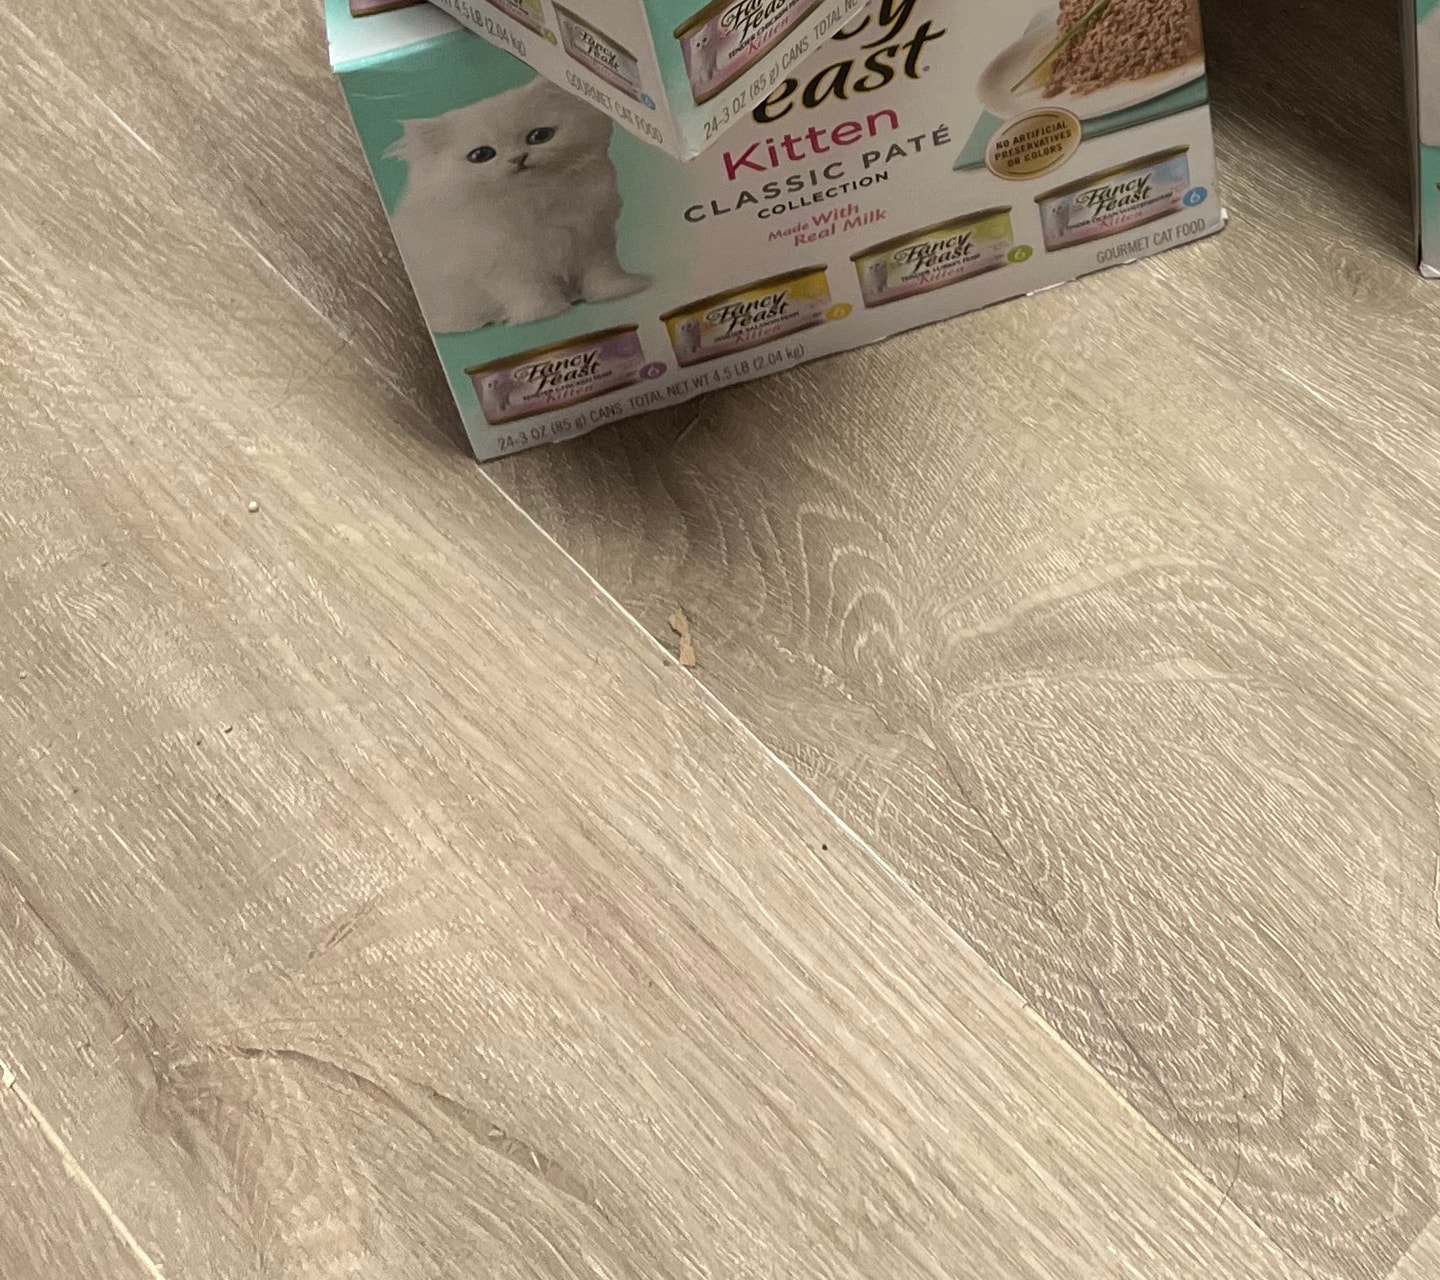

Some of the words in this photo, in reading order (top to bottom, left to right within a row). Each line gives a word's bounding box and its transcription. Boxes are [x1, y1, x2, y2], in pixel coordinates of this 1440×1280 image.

[751, 19, 949, 126] east
[683, 157, 847, 224] CLASSIC
[863, 124, 952, 169] PATÉ
[723, 107, 900, 182] Kitten
[757, 170, 890, 220] COLLECTION
[767, 222, 810, 242] Made
[810, 202, 860, 228] With
[793, 223, 842, 247] Real
[844, 206, 887, 232] Milk
